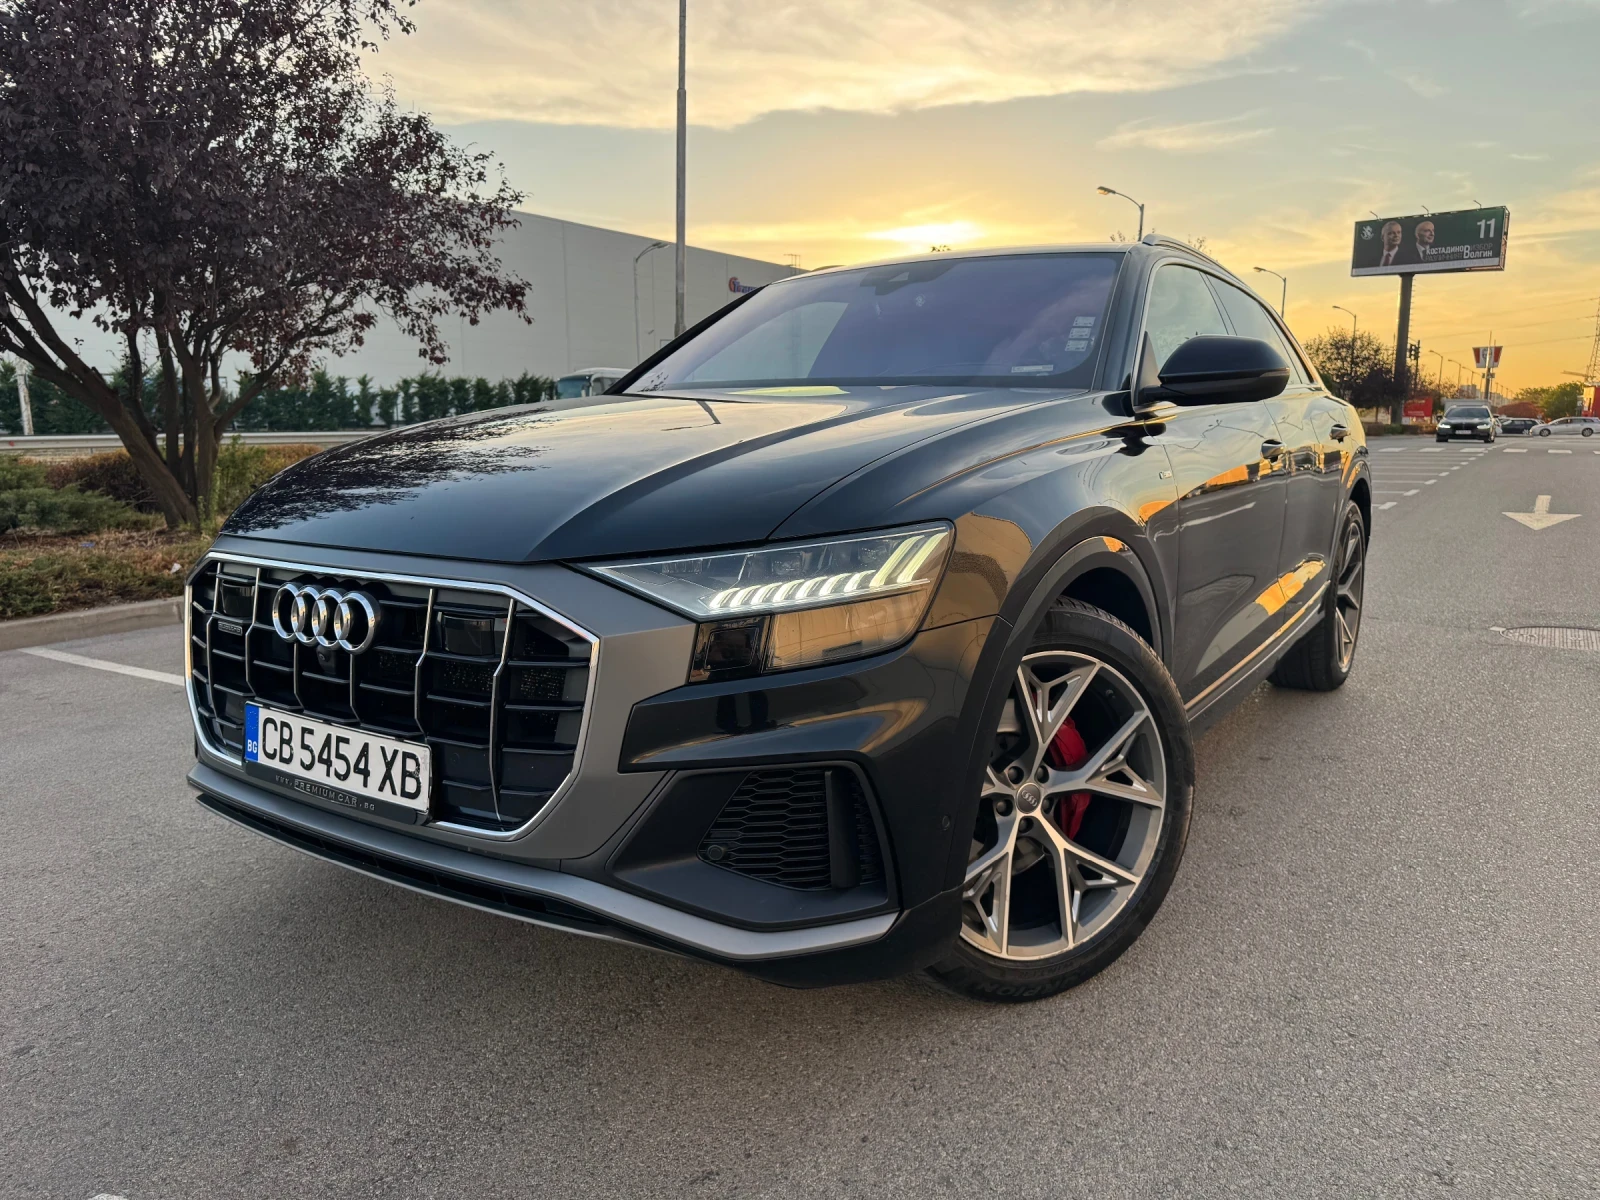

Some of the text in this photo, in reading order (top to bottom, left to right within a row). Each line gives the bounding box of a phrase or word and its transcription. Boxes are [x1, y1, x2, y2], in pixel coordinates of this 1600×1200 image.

[1477, 218, 1496, 239] 11
[247, 739, 258, 753] BG
[262, 716, 294, 765] CB
[300, 726, 371, 788] 5454
[377, 745, 422, 800] XB
